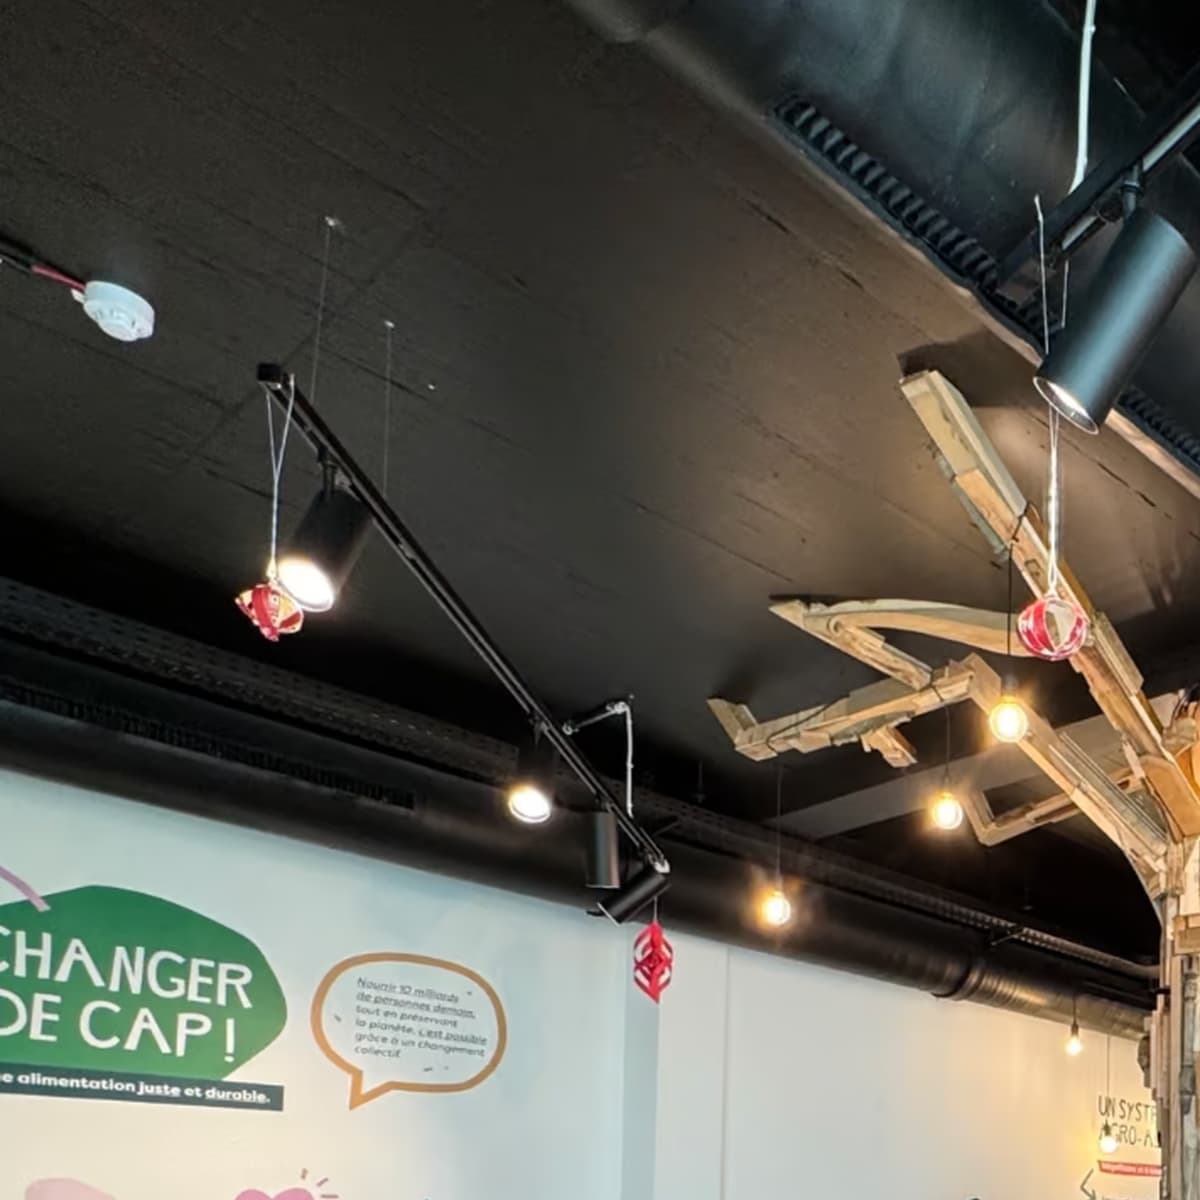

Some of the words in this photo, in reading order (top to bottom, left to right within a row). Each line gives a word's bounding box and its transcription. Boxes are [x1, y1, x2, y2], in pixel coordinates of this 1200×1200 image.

[414, 987, 459, 1003] milliards
[356, 1005, 380, 1015] tout
[383, 1009, 397, 1018] en
[373, 996, 430, 1012] personnes
[418, 1041, 485, 1057] changement
[17, 1072, 135, 1092] alimentation
[138, 1081, 181, 1097] juste
[184, 1087, 201, 1097] et
